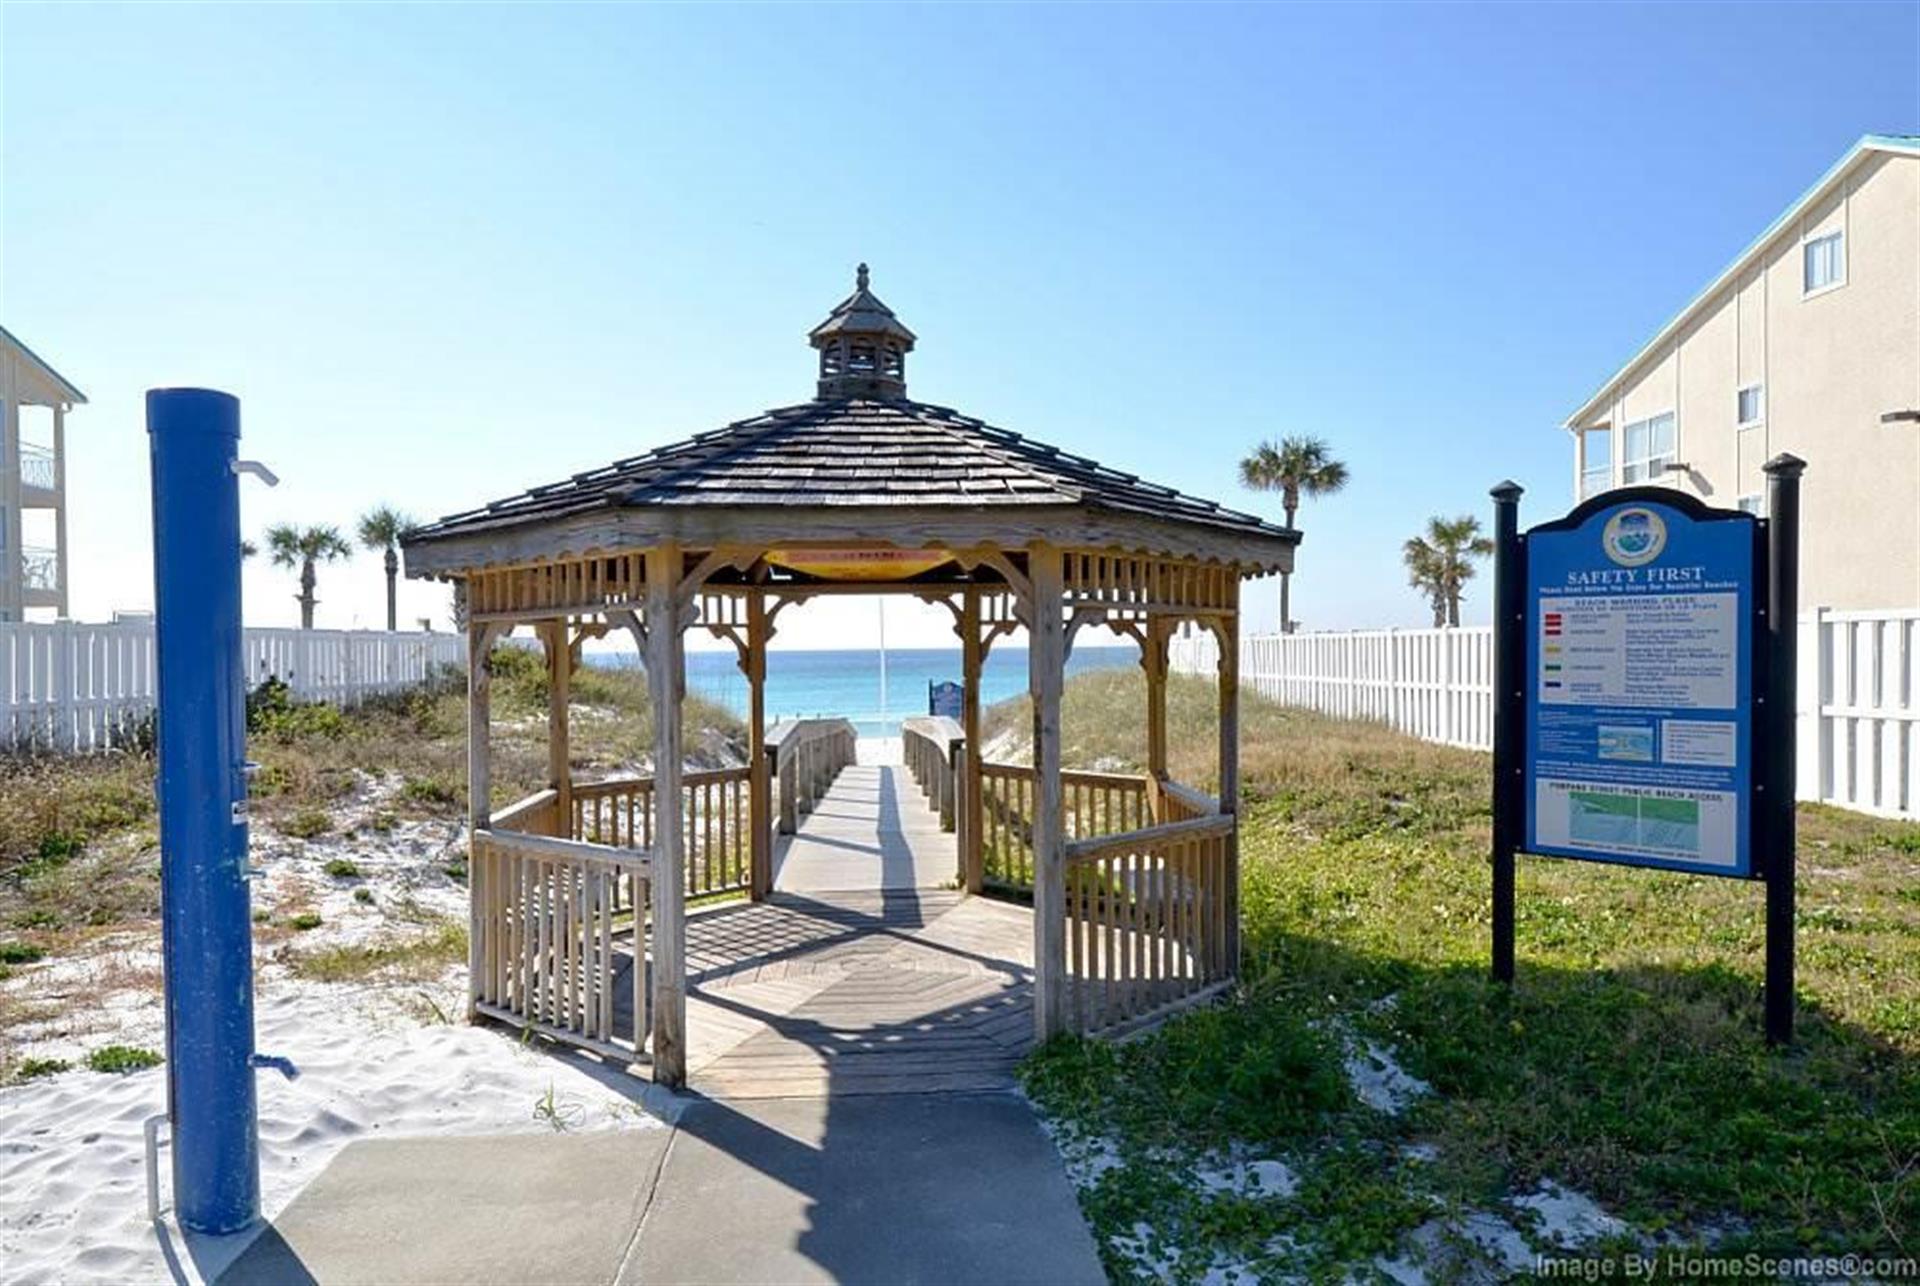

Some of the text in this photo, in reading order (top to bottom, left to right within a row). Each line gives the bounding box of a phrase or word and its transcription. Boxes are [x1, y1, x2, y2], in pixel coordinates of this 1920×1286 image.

[1567, 567, 1705, 585] SAFETY FIRST
[1656, 789, 1685, 799] BEACH
